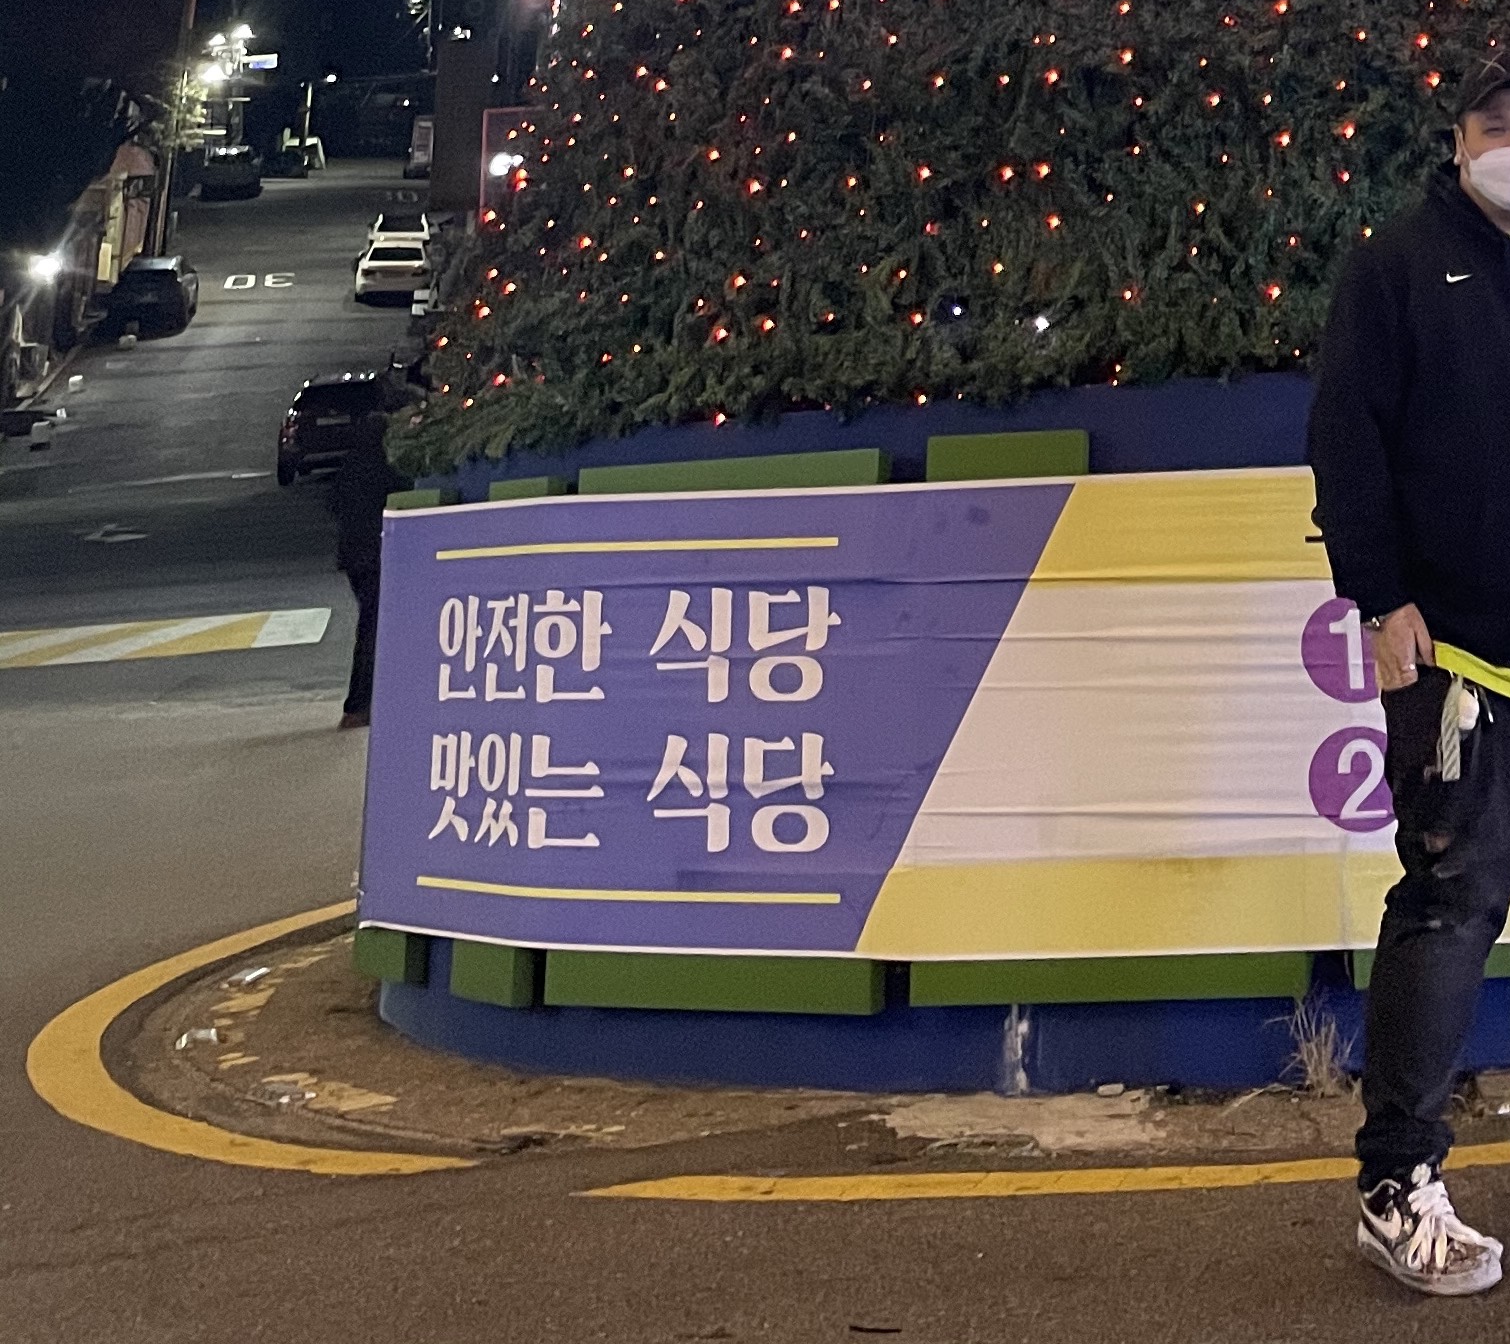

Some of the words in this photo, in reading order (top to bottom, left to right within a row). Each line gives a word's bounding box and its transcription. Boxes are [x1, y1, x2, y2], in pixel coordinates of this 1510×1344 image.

[437, 588, 612, 703] 안전한
[650, 585, 842, 703] 식당
[427, 731, 604, 848] 맛있는
[646, 731, 835, 853] 식당
